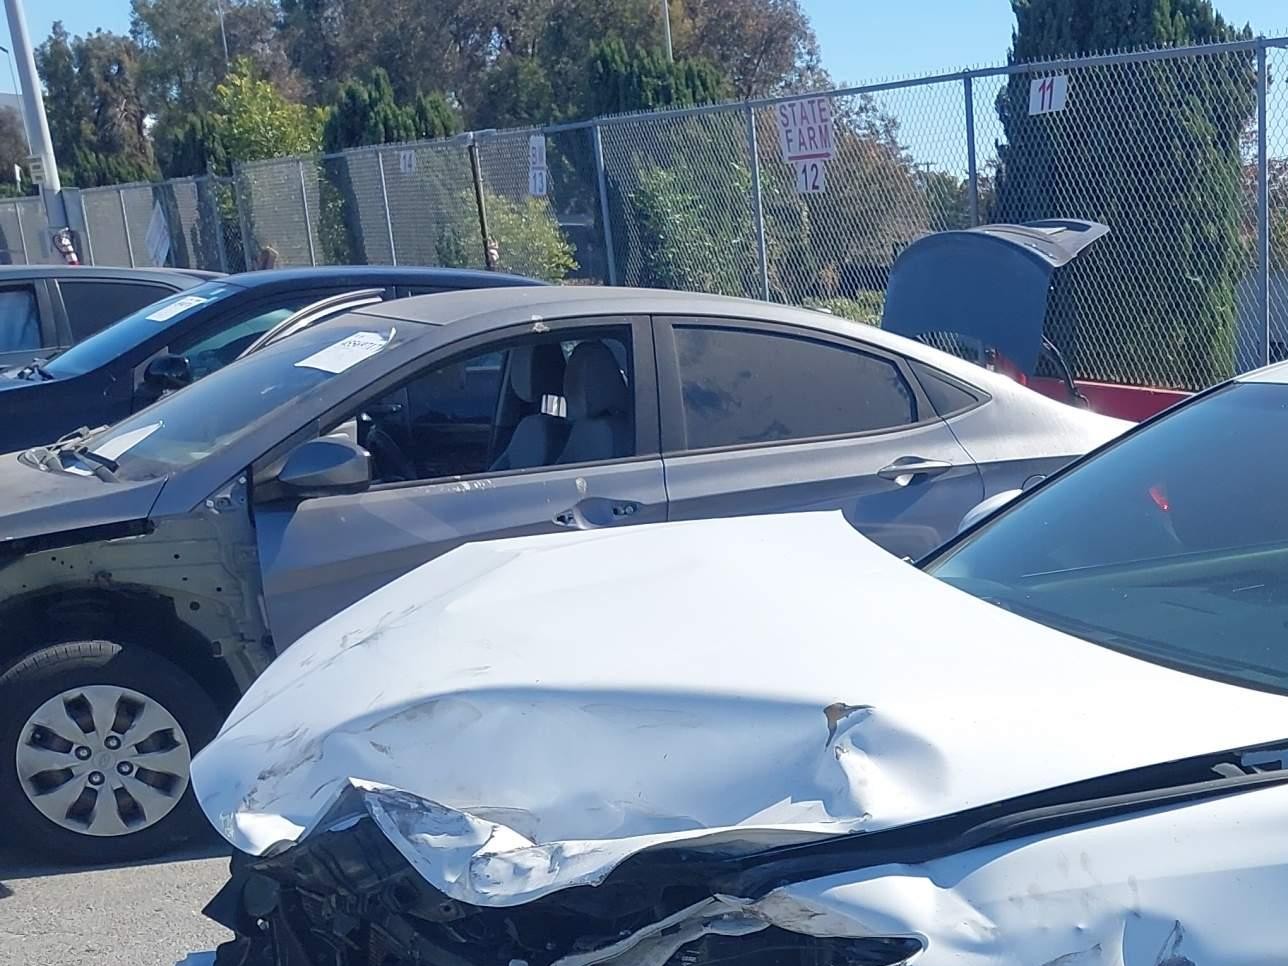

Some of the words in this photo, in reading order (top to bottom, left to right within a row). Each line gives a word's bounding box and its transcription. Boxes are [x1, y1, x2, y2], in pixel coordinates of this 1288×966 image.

[1039, 78, 1054, 111] 11
[779, 98, 828, 128] STATE
[785, 124, 832, 153] FARM
[801, 162, 820, 191] 12
